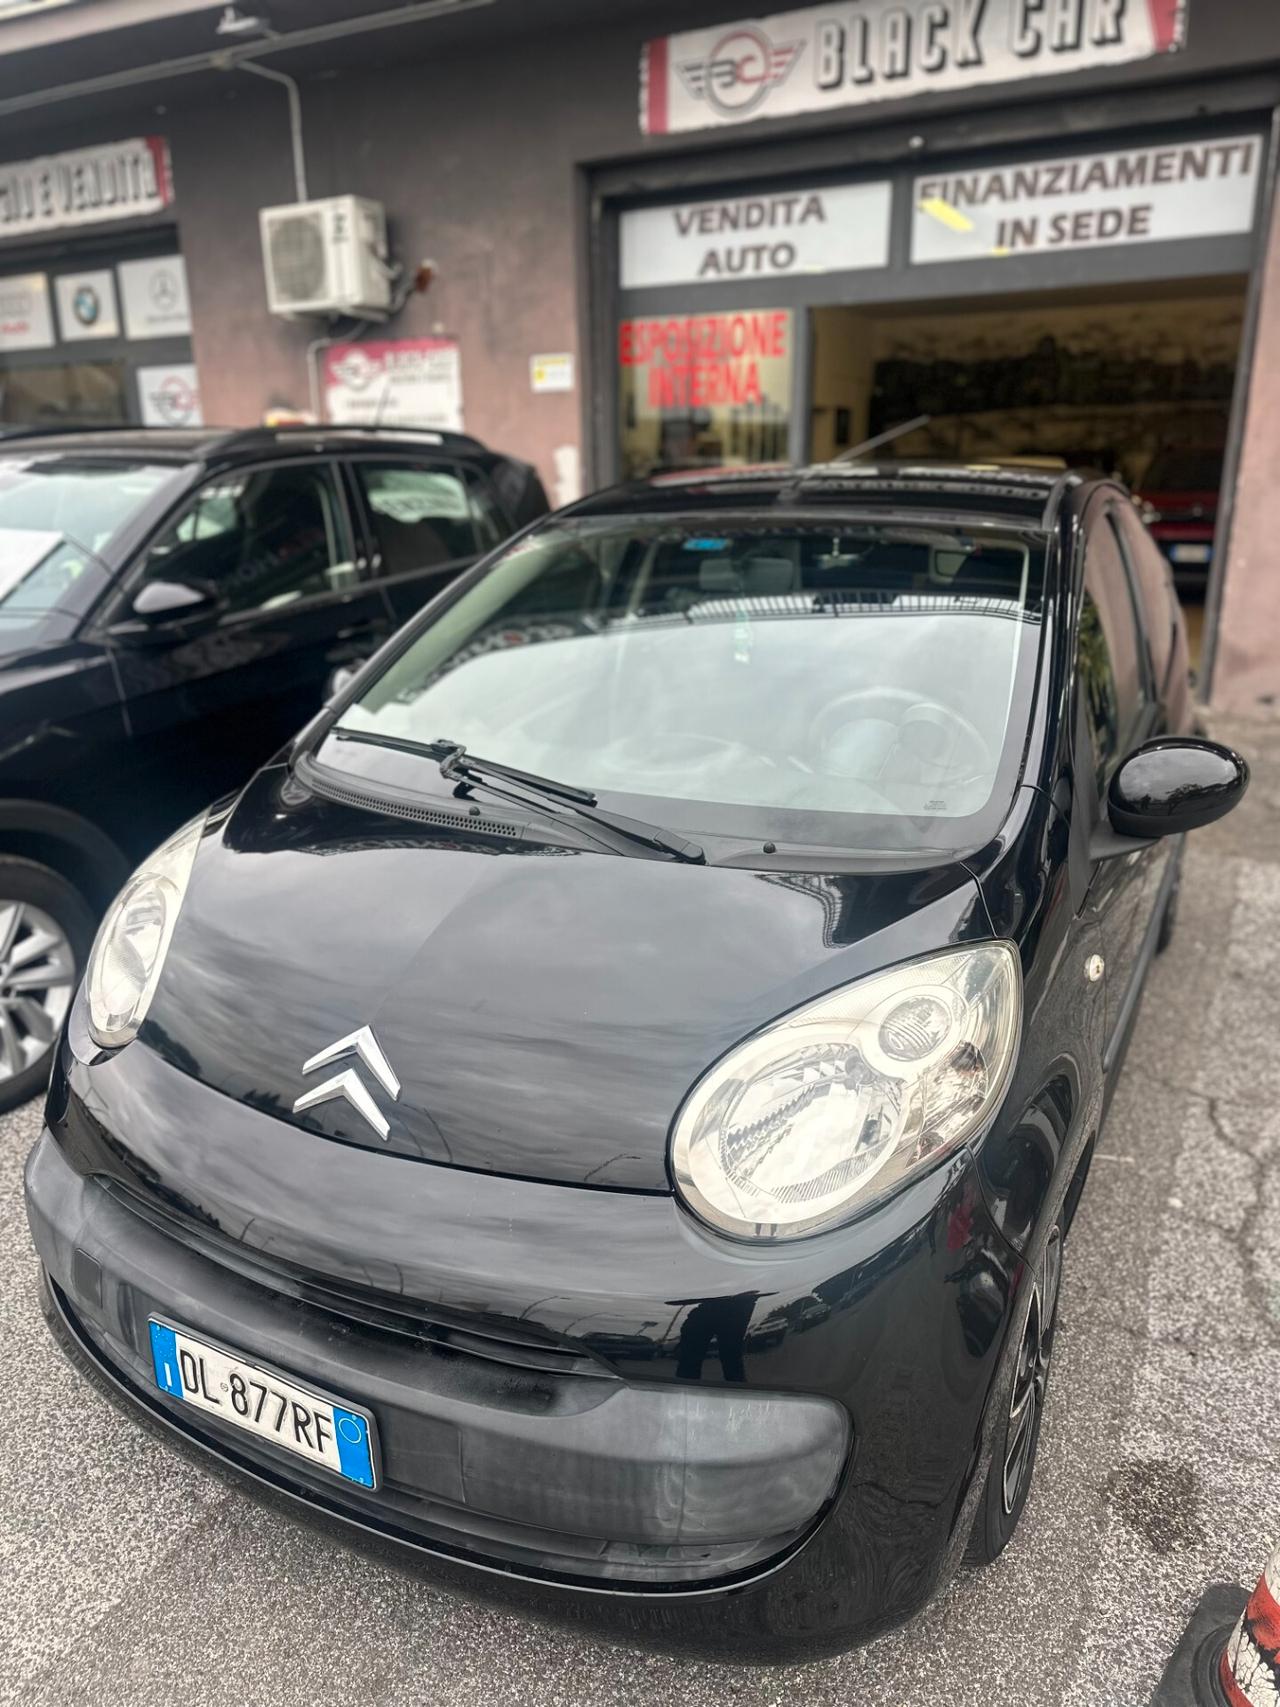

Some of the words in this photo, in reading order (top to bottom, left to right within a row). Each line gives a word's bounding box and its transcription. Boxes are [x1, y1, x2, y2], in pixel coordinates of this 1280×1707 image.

[815, 0, 984, 91] BLACK
[1012, 0, 1126, 58] CAR
[917, 143, 1255, 214] FINANZIAMENTI
[674, 195, 826, 237] VENDITA
[997, 217, 1039, 250] IN
[1048, 205, 1154, 245] SEDE
[699, 243, 795, 277] AUTO
[619, 309, 789, 367] ESPOSIZIONE
[648, 362, 763, 409] INTERNA
[179, 1348, 221, 1405] DL
[229, 1372, 333, 1453] 877RF
